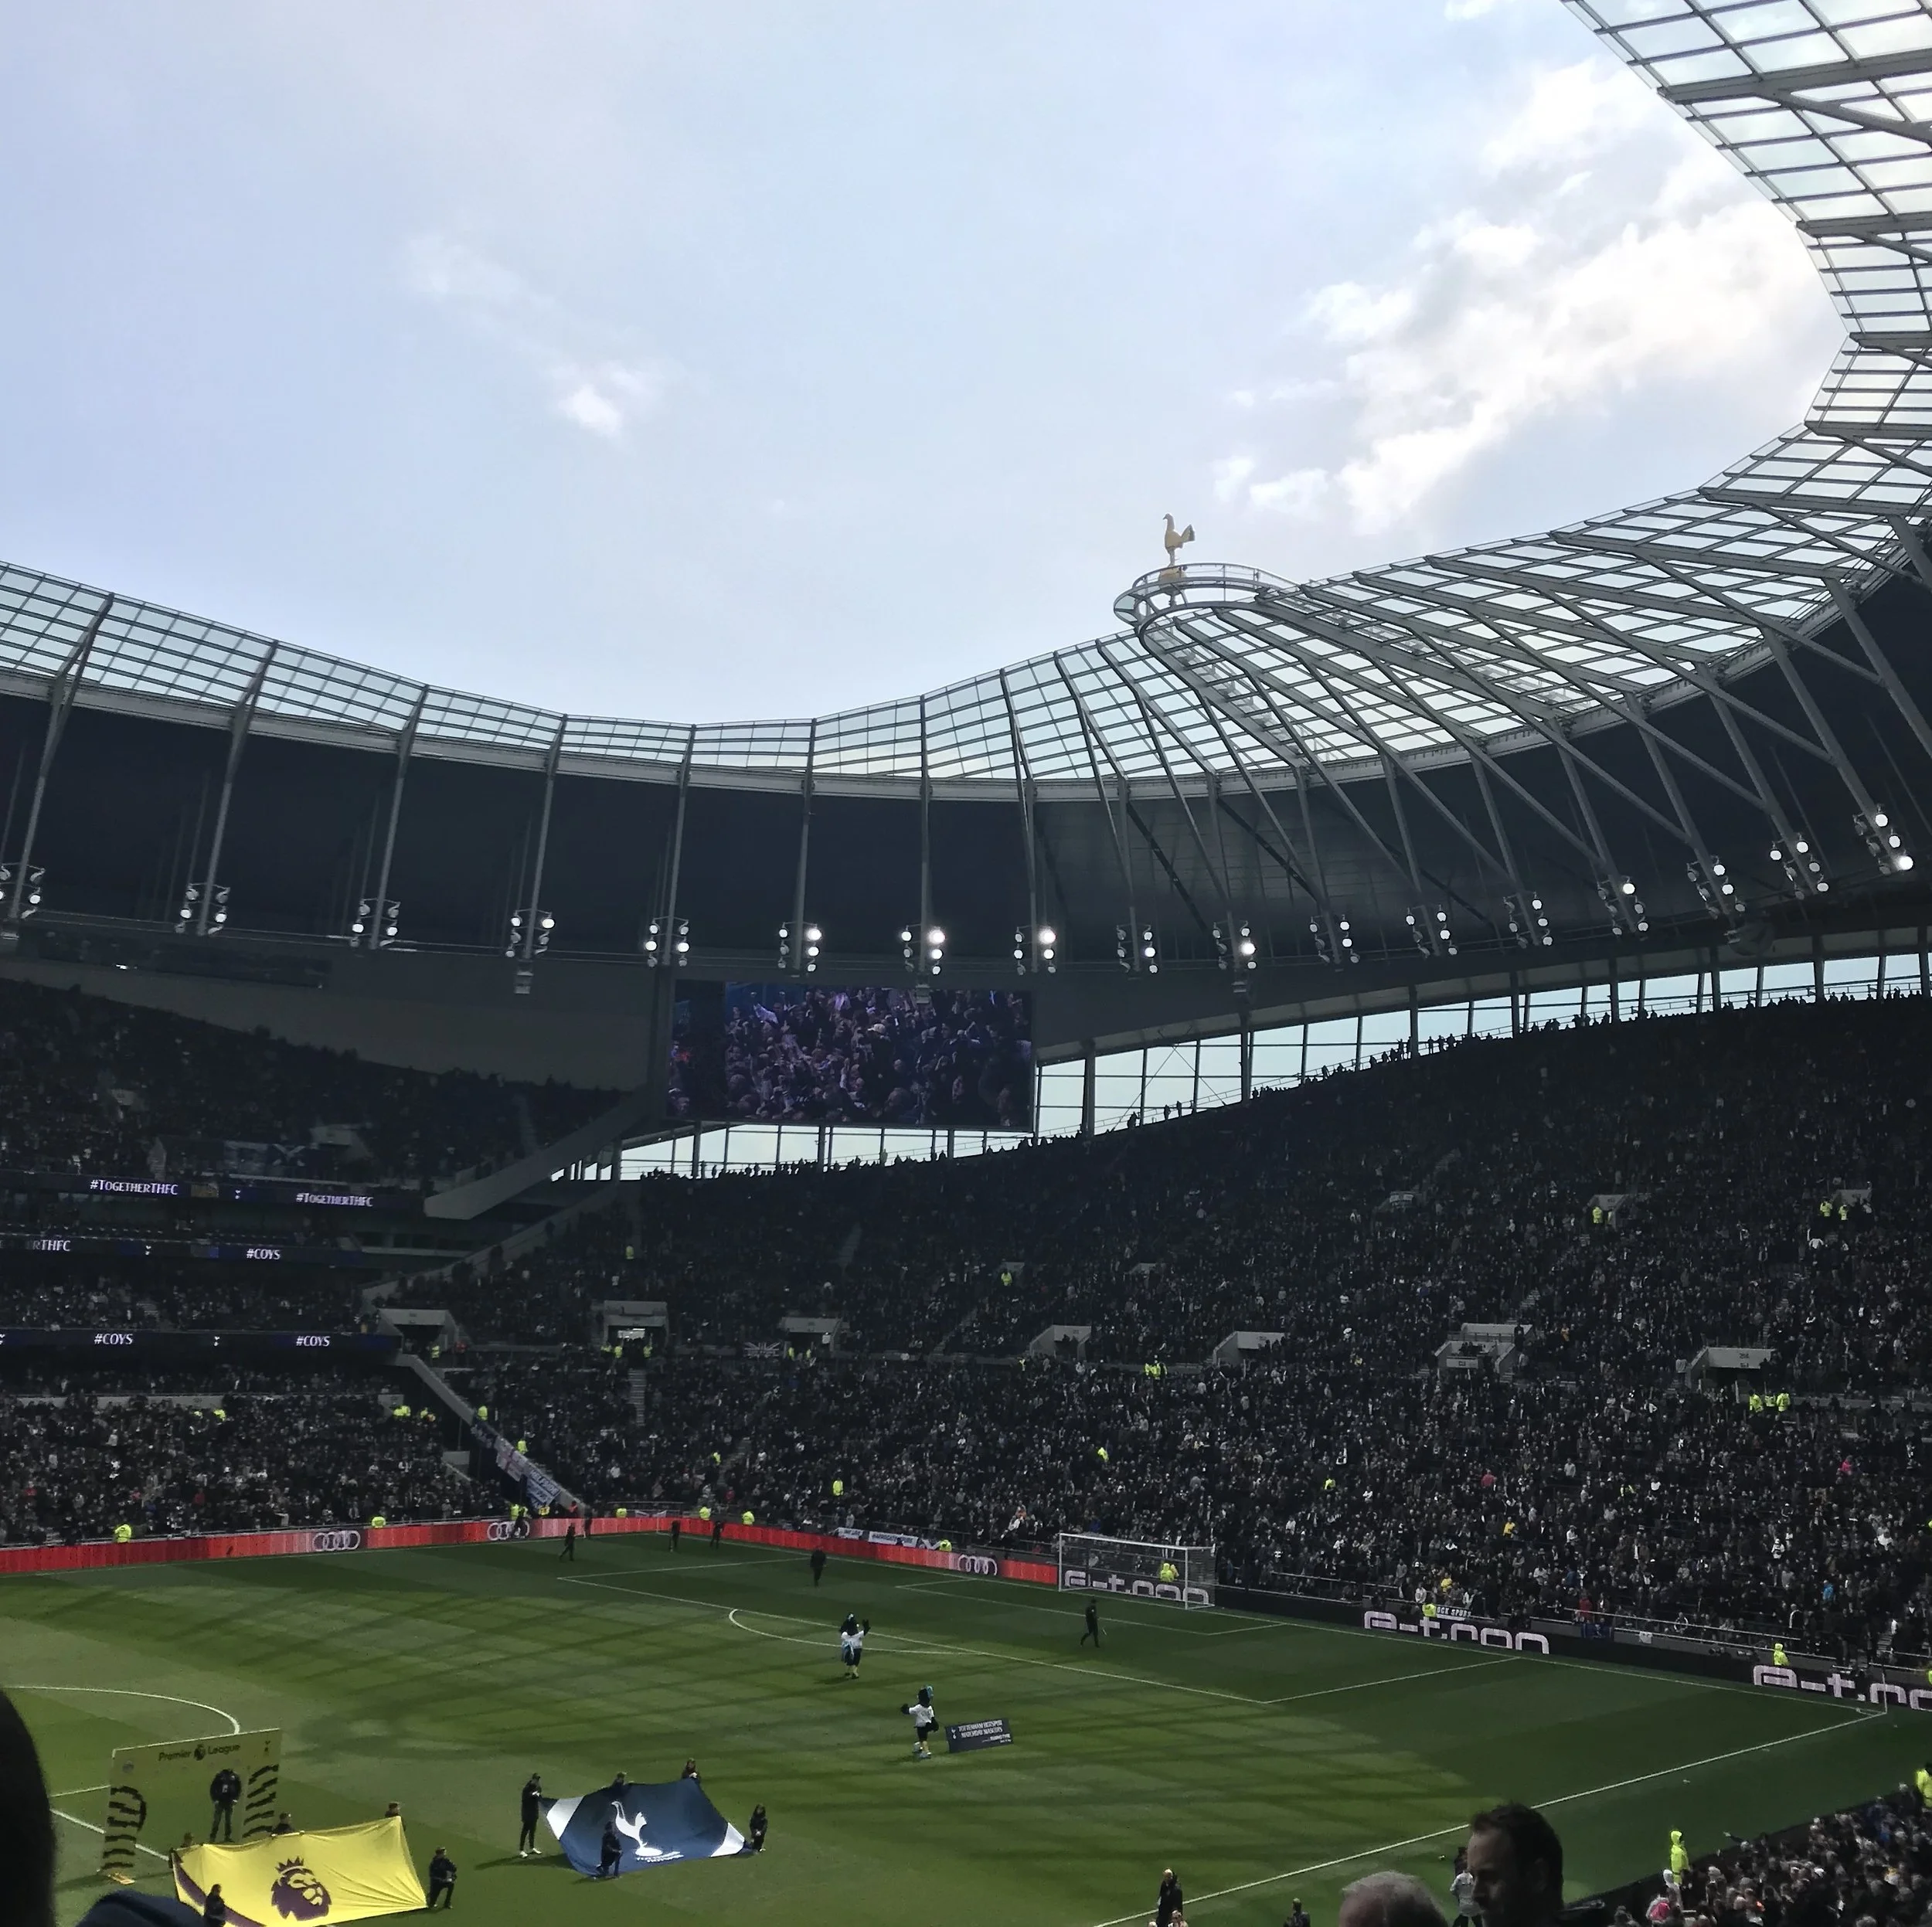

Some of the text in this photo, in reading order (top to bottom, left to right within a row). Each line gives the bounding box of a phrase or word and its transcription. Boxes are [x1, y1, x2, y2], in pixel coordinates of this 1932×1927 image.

[247, 1248, 281, 1259] #COYS
[94, 1333, 134, 1344] #COYS
[296, 1335, 331, 1347] #COYS
[1064, 1569, 1209, 1606] e-tron
[1363, 1611, 1549, 1654] e-tron
[158, 1745, 240, 1761] Premier League
